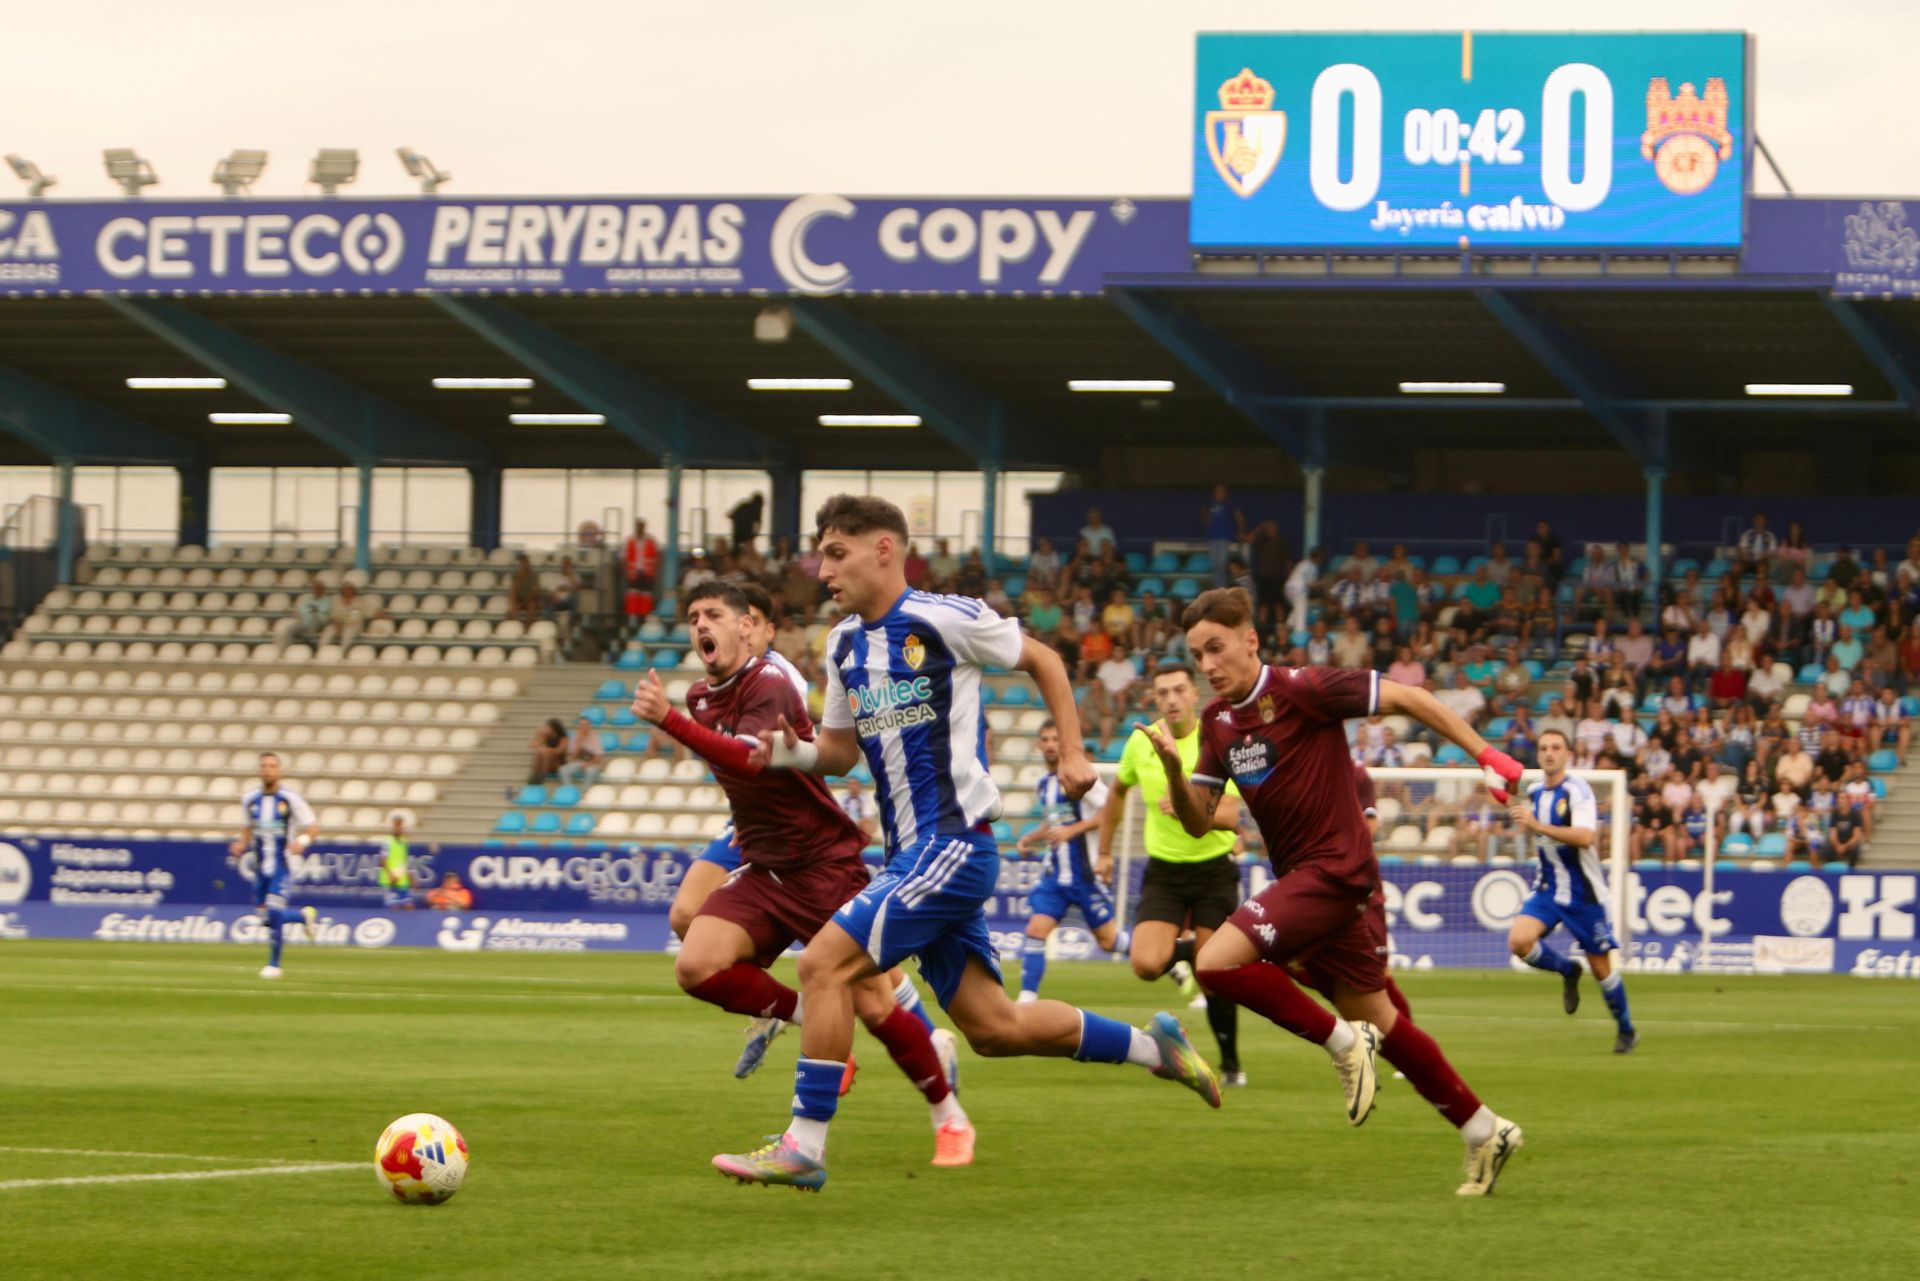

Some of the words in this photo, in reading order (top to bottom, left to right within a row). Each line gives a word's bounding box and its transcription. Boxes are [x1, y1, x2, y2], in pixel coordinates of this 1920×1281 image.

[1310, 63, 1382, 211] 0
[1404, 108, 1526, 164] 00:42
[1541, 63, 1613, 211] 0
[428, 203, 746, 264] PERYBRAS
[1467, 196, 1565, 232] calvo
[96, 214, 404, 278] CETECO
[878, 208, 1096, 283] copy
[857, 703, 937, 738] CRICURSA
[1229, 743, 1267, 761] Estrella
[1231, 756, 1267, 775] Galicia
[92, 912, 226, 942] Estrella
